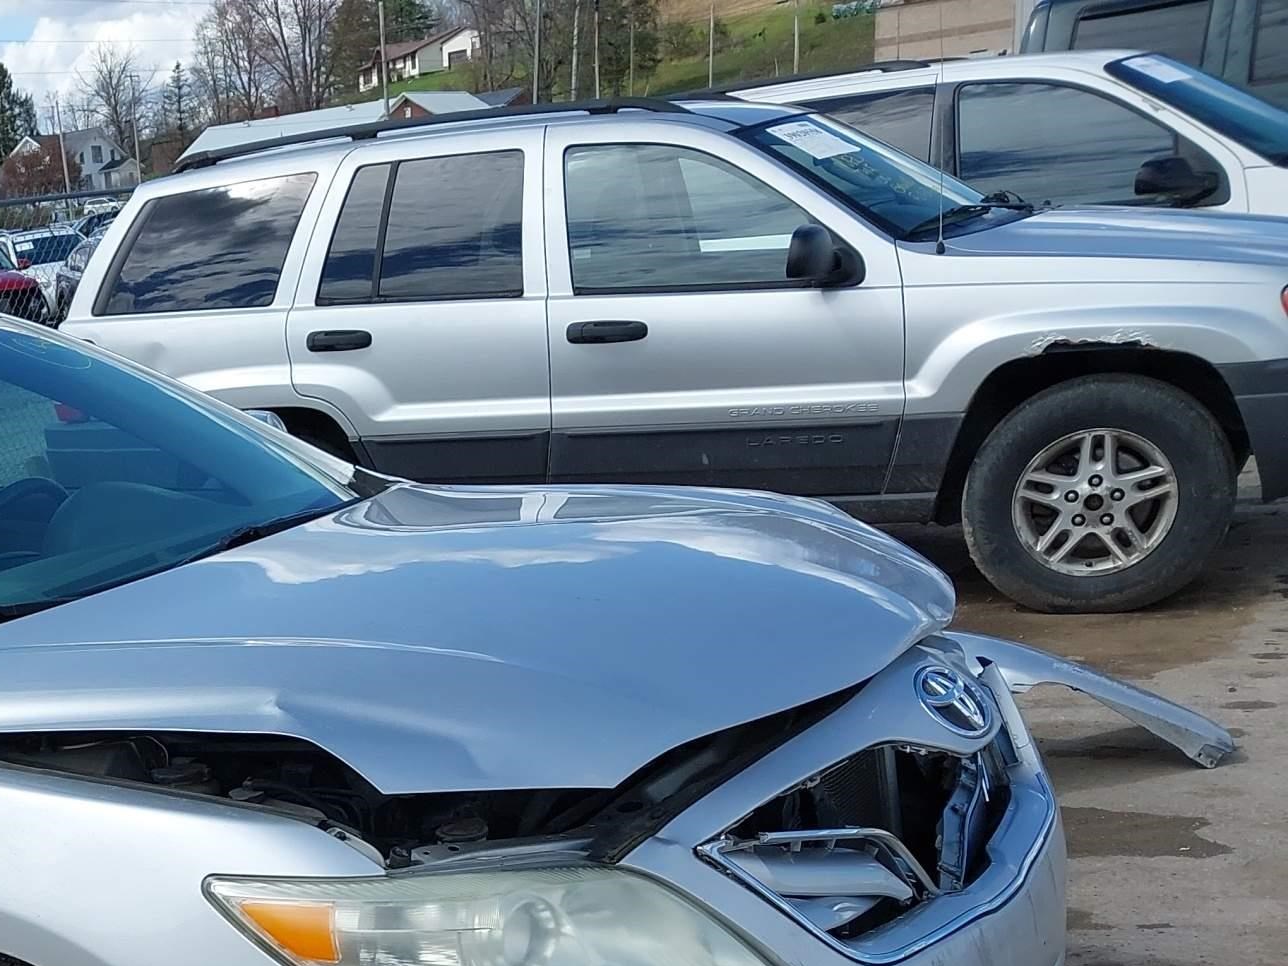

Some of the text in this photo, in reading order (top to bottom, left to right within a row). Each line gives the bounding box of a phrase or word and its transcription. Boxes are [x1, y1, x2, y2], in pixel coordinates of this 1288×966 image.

[728, 402, 880, 418] GRAND CHEROKEE
[746, 434, 844, 448] LAREDO
